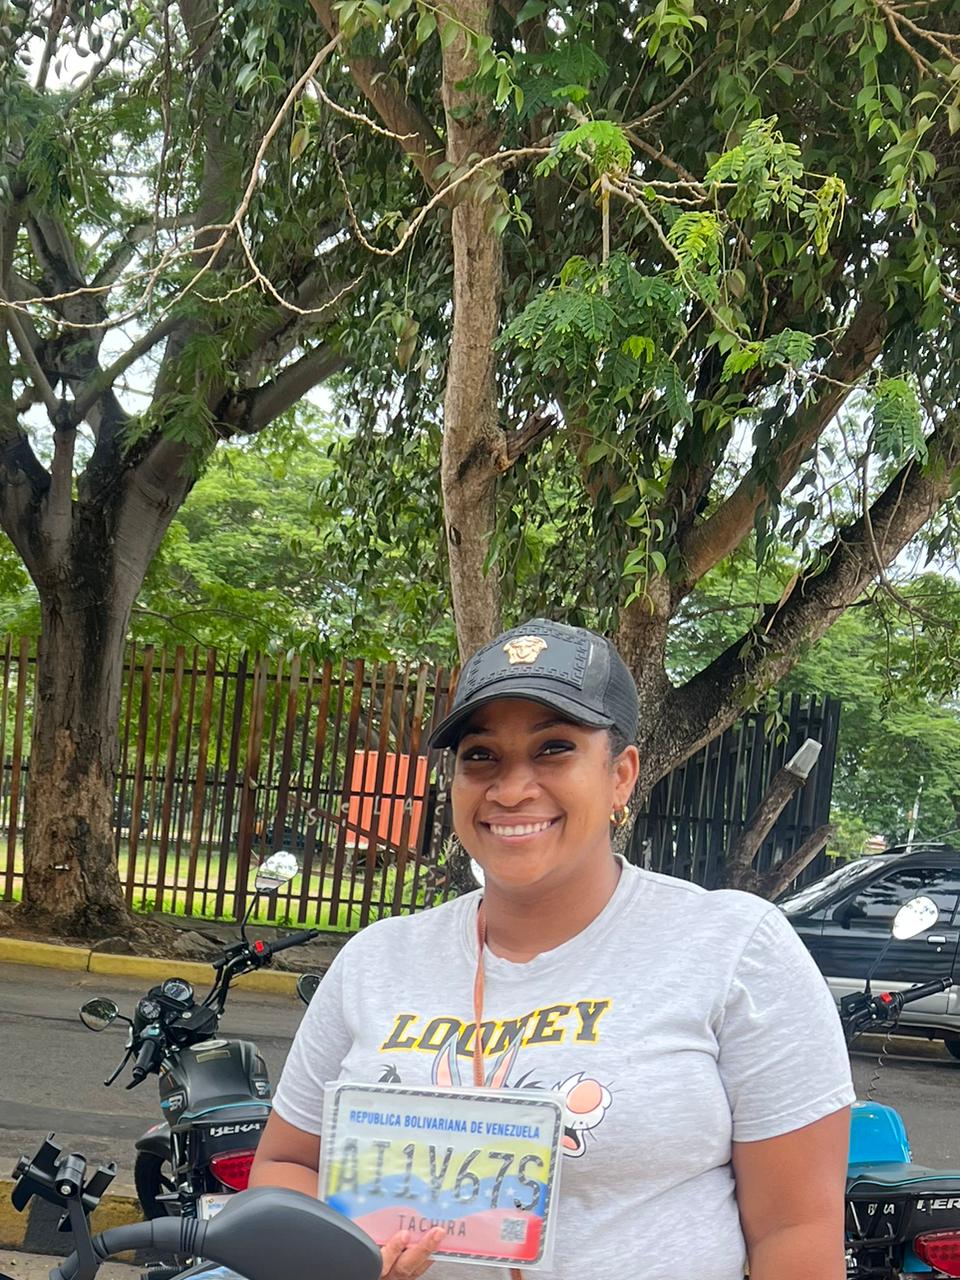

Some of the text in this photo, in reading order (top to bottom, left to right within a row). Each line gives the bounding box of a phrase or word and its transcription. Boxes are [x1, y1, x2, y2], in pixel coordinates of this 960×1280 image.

[381, 998, 611, 1058] LOONEY
[349, 1110, 540, 1139] REPUBLICA BOLIVARIANA DE VENEZUELA
